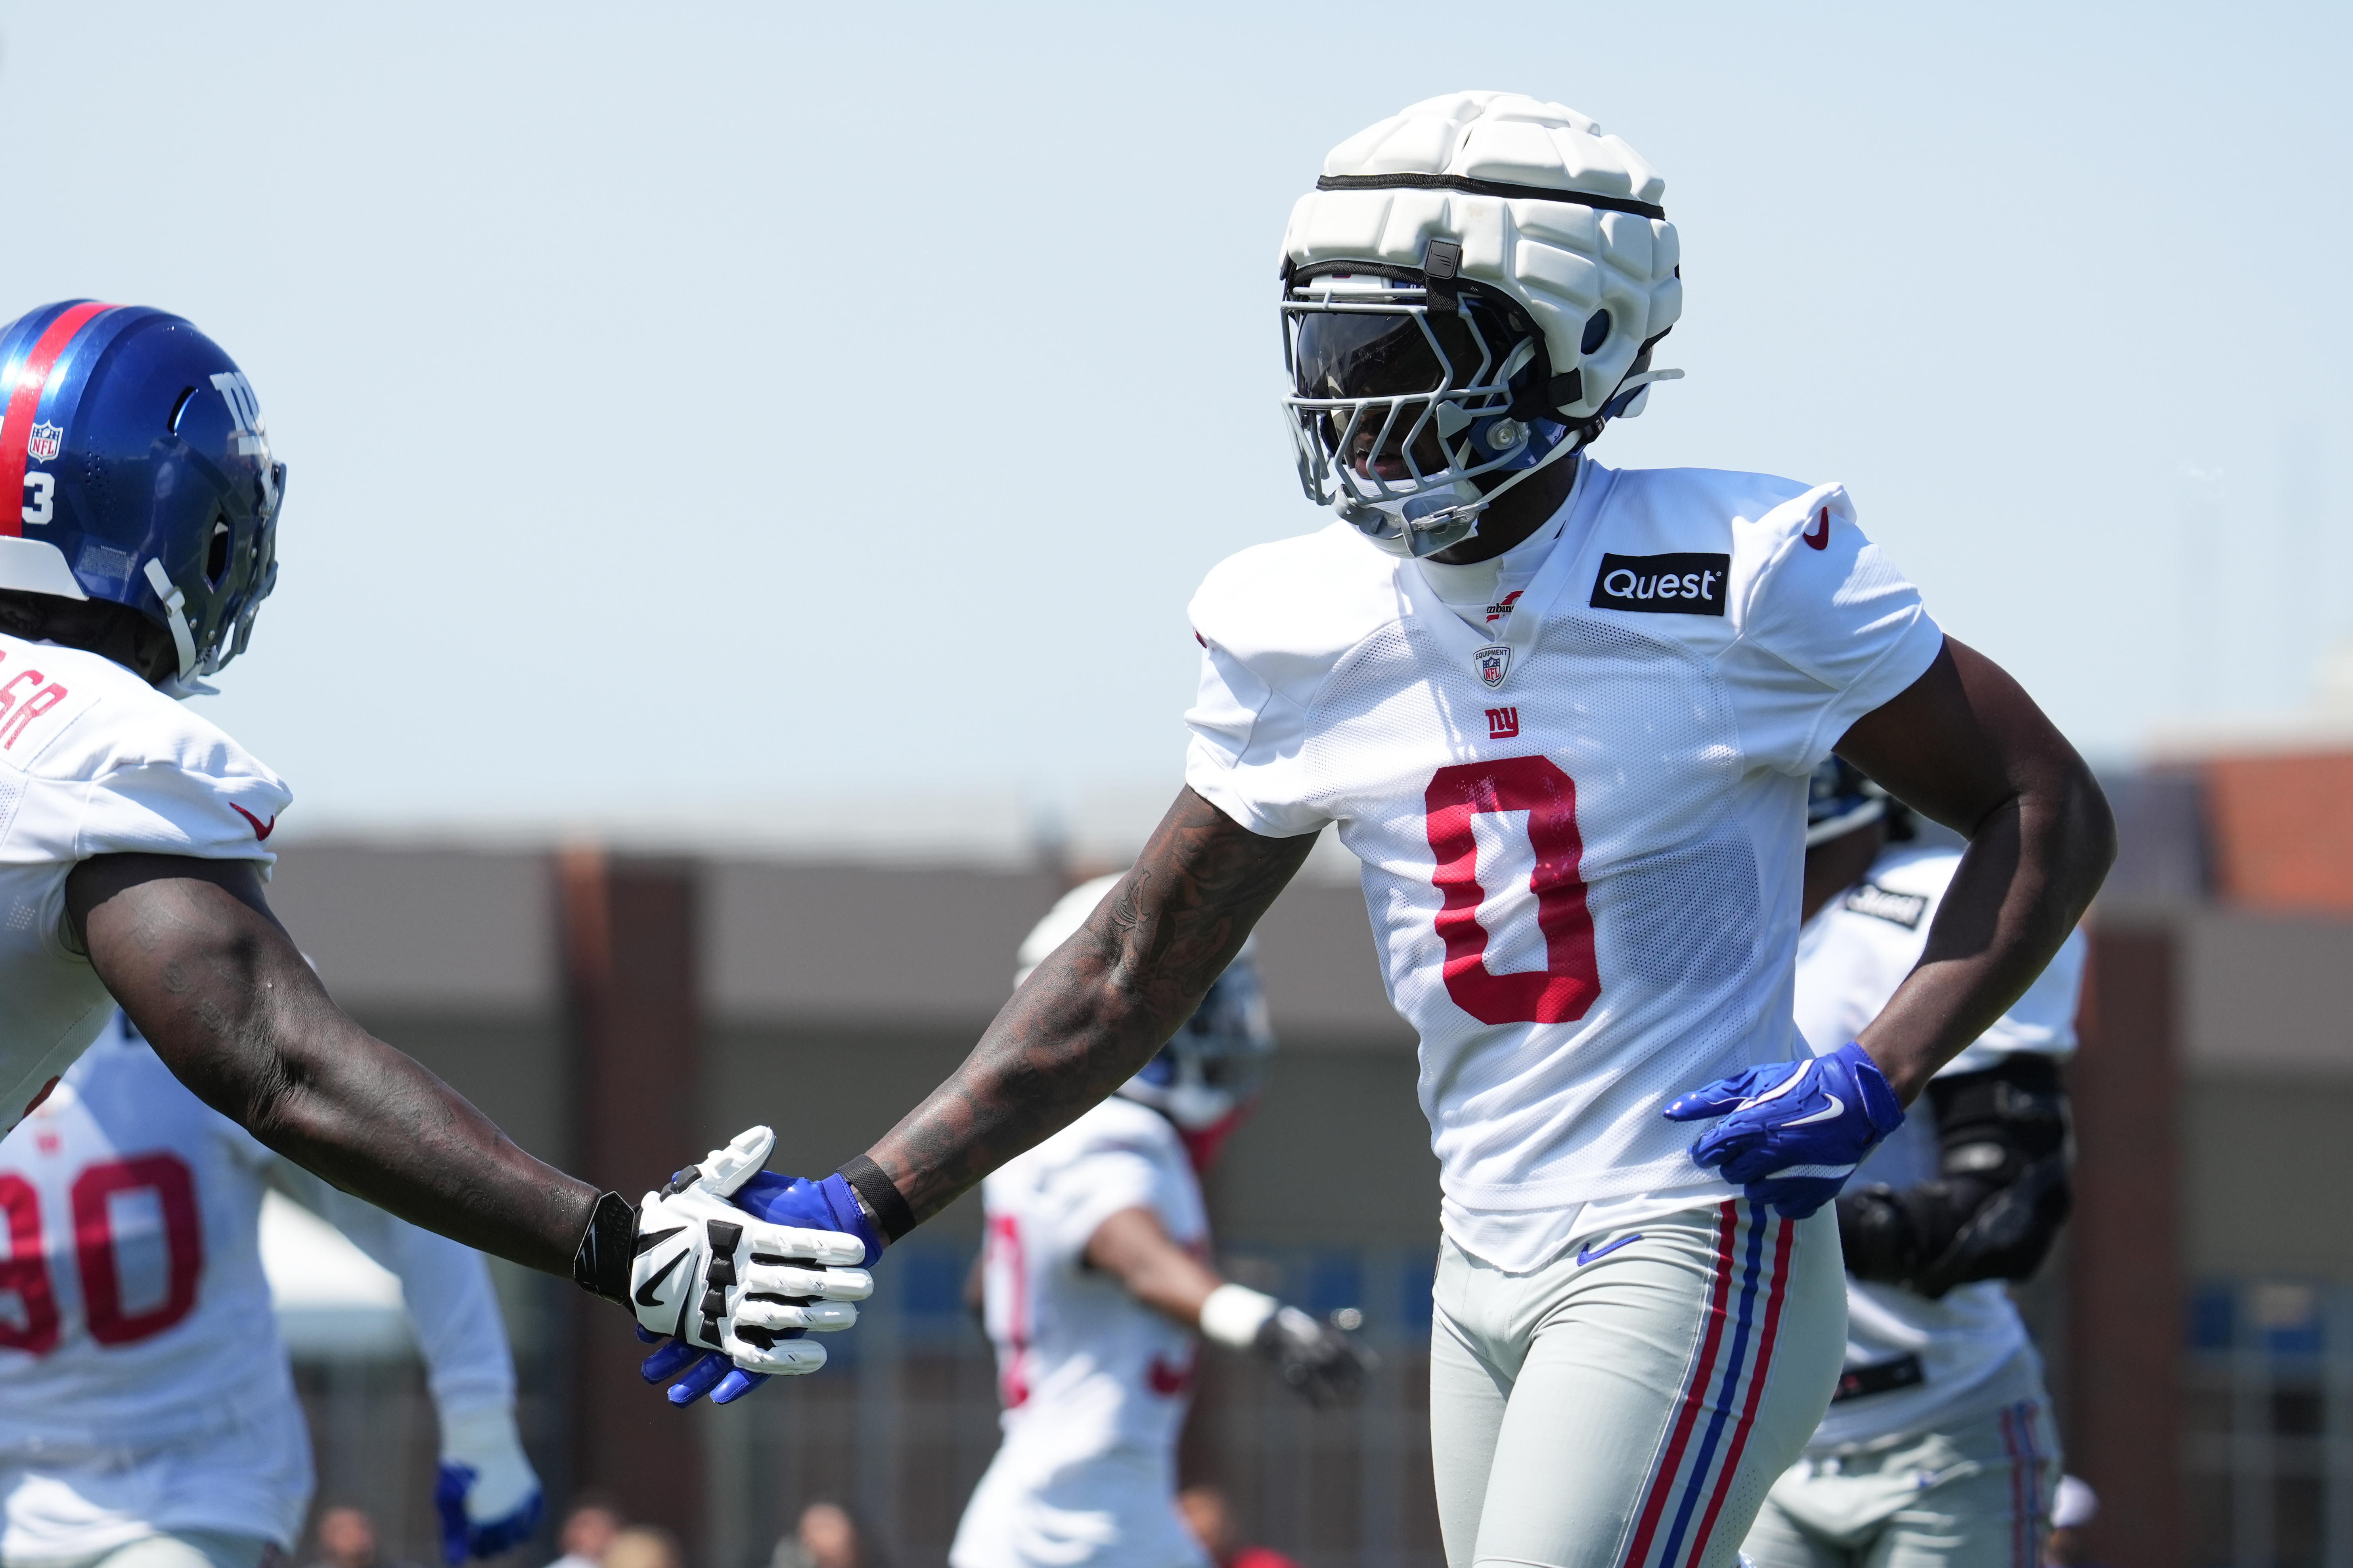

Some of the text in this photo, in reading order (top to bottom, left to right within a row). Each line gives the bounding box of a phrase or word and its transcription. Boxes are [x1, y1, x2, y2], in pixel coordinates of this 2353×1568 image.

[33, 438, 54, 455] NFL
[22, 471, 55, 525] 3
[1604, 569, 1716, 600] Quest
[1476, 649, 1508, 660] EQUIPMENT
[1485, 667, 1499, 680] NFL
[1424, 755, 1602, 1025] 0
